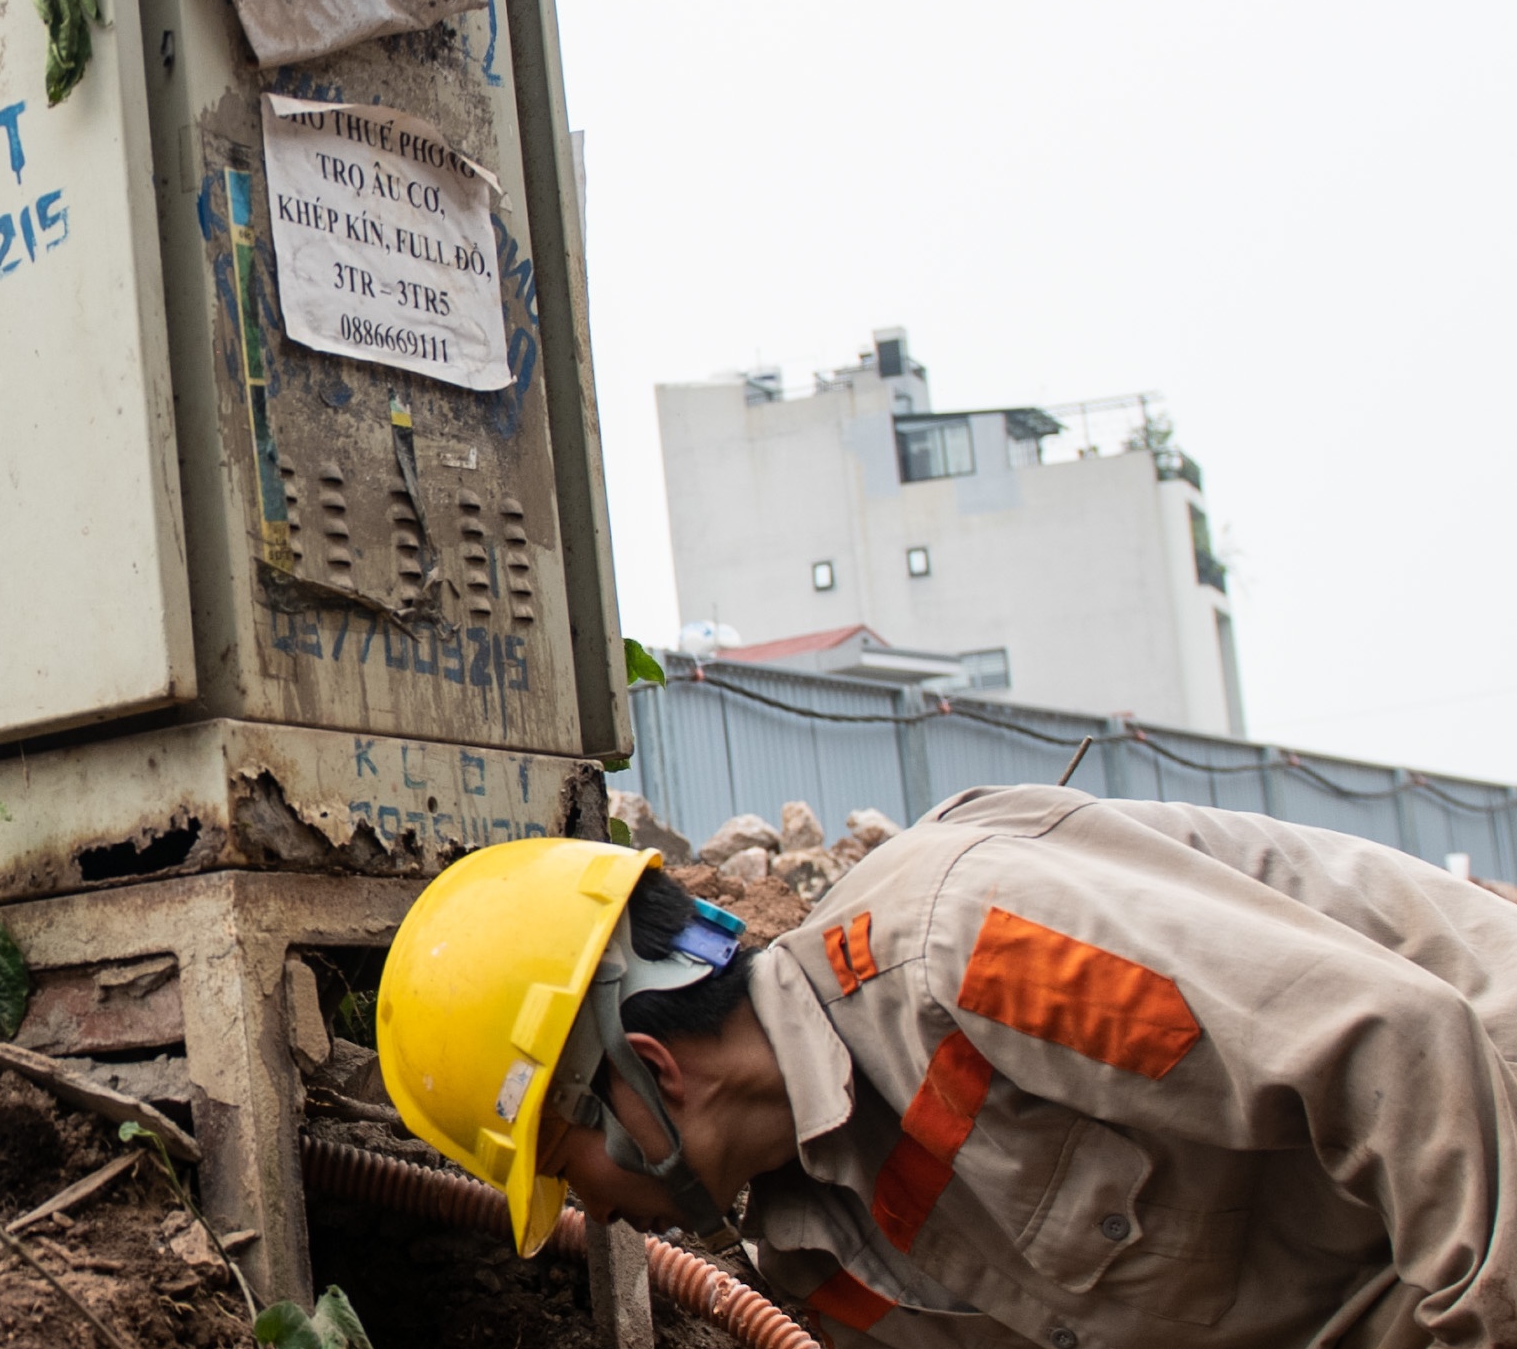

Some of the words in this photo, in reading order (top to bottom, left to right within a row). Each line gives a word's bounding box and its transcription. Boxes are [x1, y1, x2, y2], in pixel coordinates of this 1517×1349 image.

[315, 152, 364, 198] TRỌ
[371, 160, 402, 202] ÂU
[406, 180, 446, 221] CƠ,
[276, 193, 339, 234] KHÉP
[345, 210, 391, 254] KÍN,
[396, 227, 451, 268] FULL
[333, 261, 377, 300] 3TR
[397, 279, 451, 317] 3TR5
[340, 312, 449, 364] 0886669111
